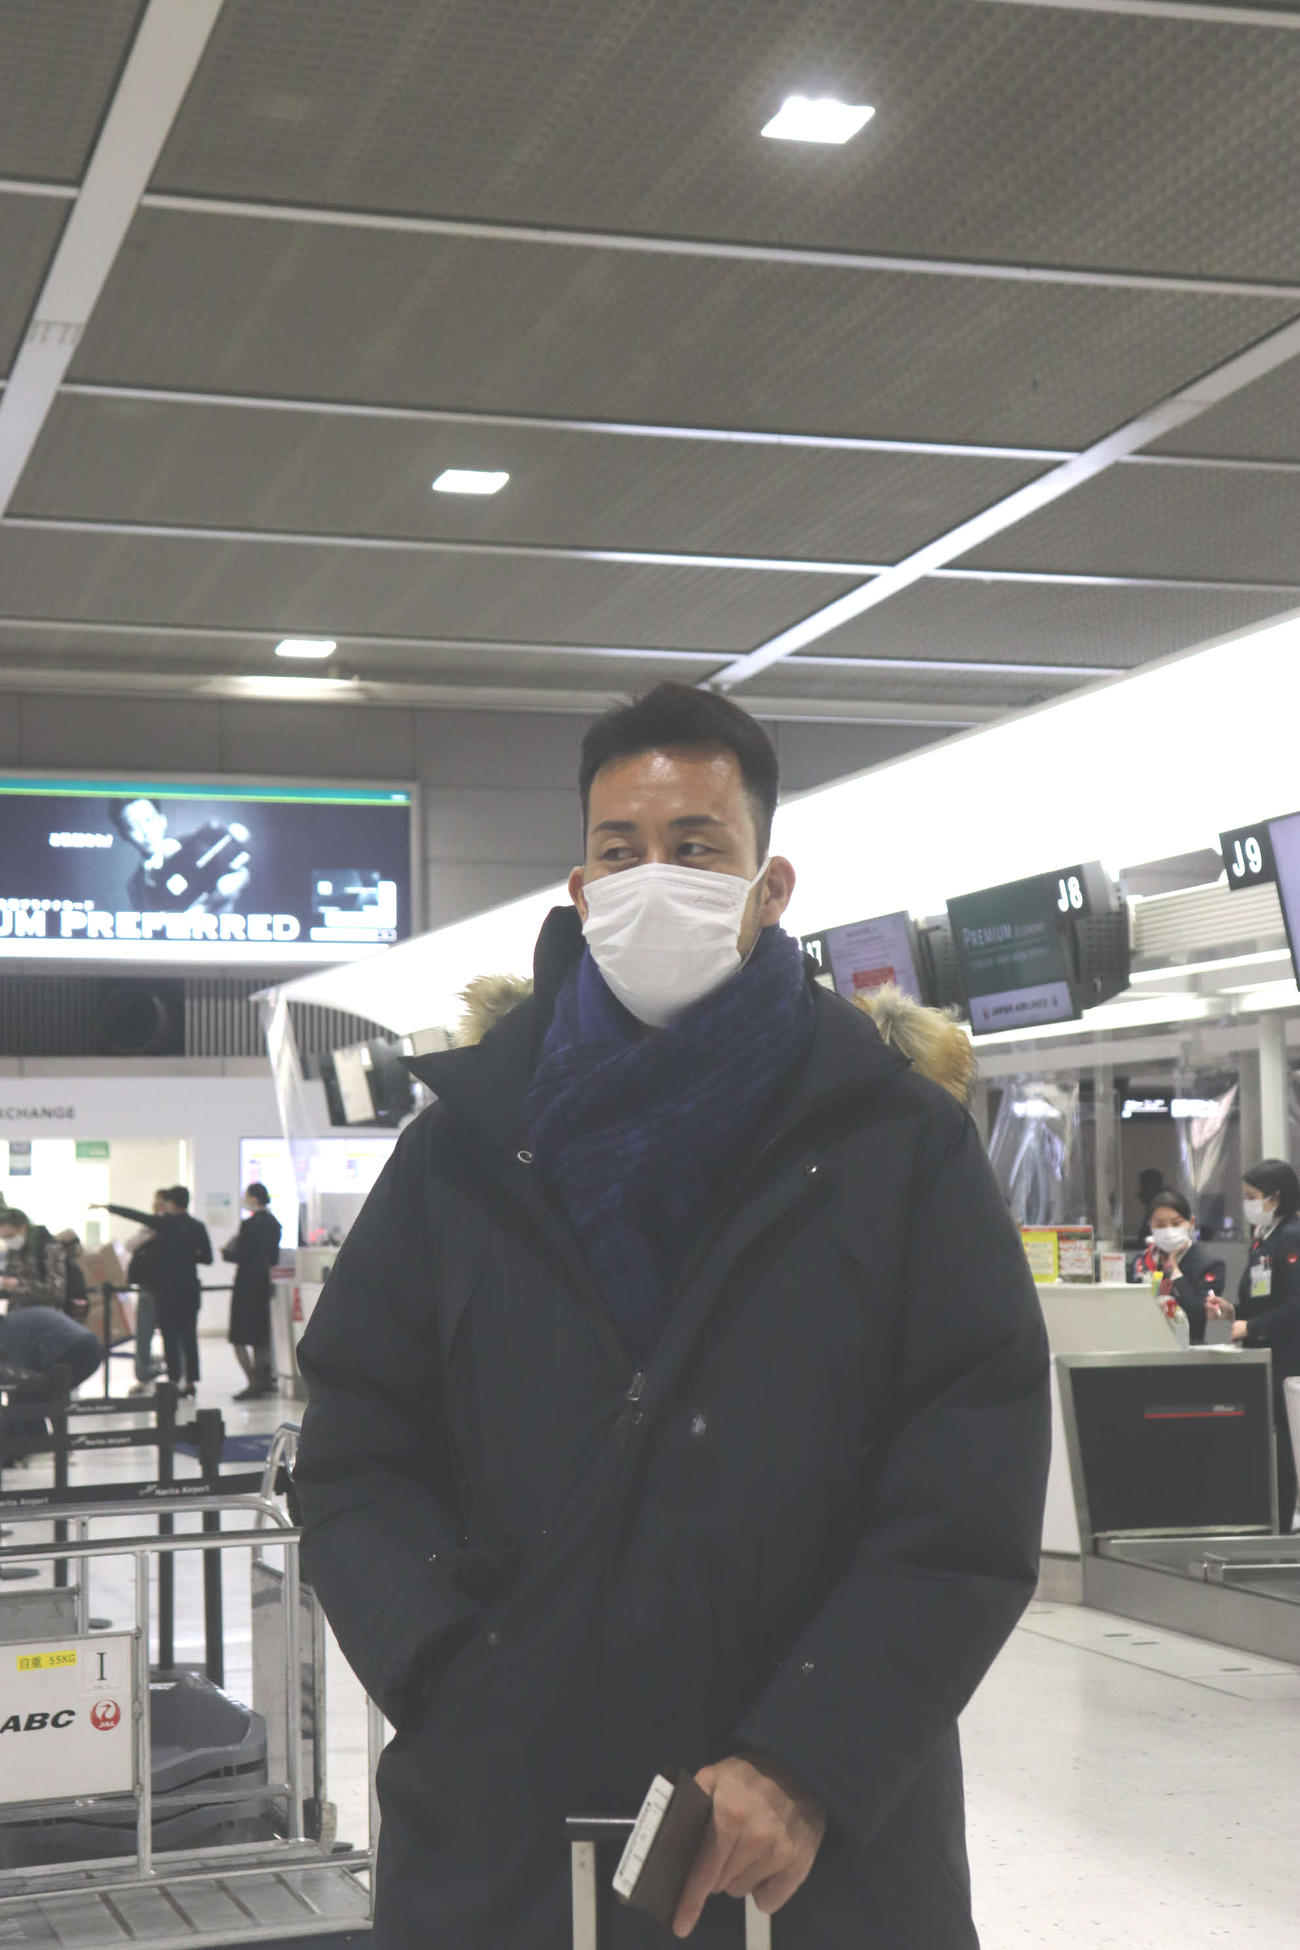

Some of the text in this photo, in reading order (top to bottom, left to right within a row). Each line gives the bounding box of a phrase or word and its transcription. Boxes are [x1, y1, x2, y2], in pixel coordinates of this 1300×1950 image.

[1232, 837, 1263, 877] J9
[1057, 876, 1084, 912] J8
[60, 910, 301, 941] PREFERRED
[154, 1484, 210, 1497] Narita Airport
[0, 1709, 76, 1733] ABC
